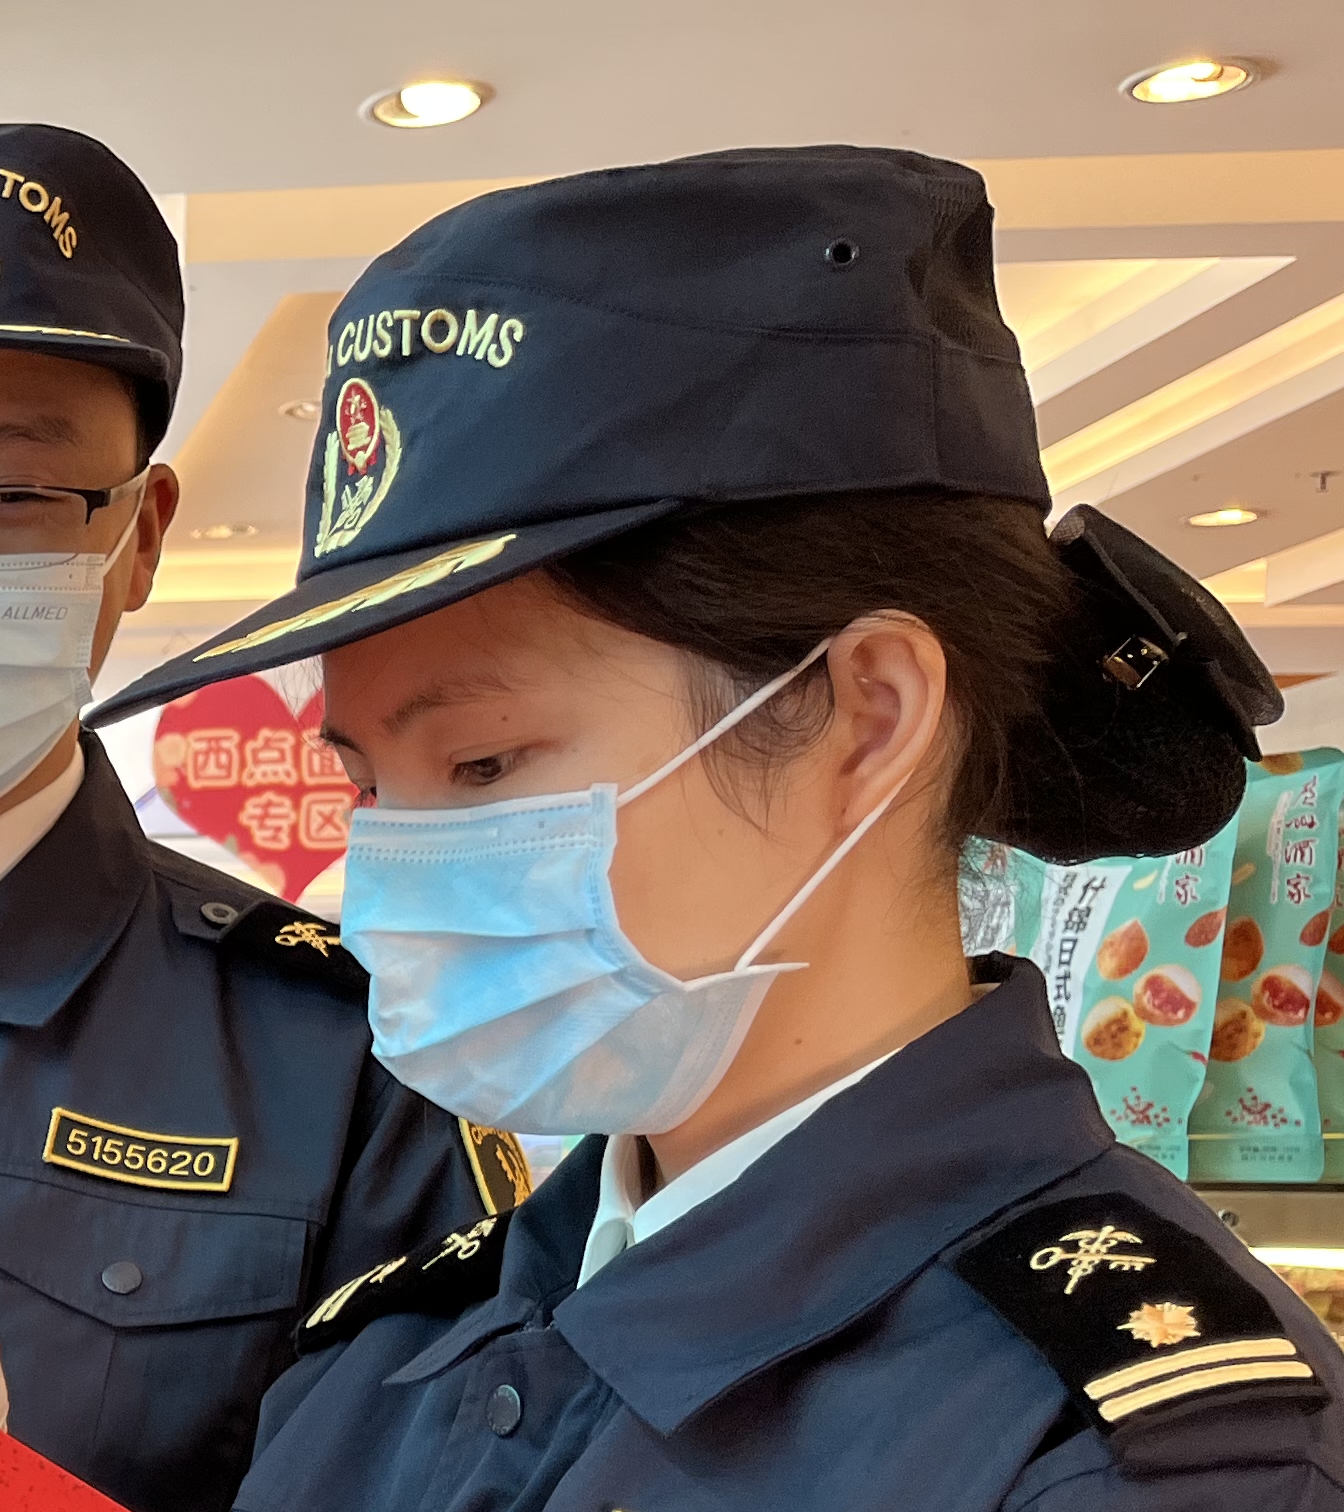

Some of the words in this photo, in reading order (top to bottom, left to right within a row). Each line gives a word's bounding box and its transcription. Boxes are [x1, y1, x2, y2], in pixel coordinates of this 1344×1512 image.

[335, 307, 525, 369] CUSTOMS
[0, 604, 70, 623] ALLMED
[63, 1126, 217, 1179] 5155620
